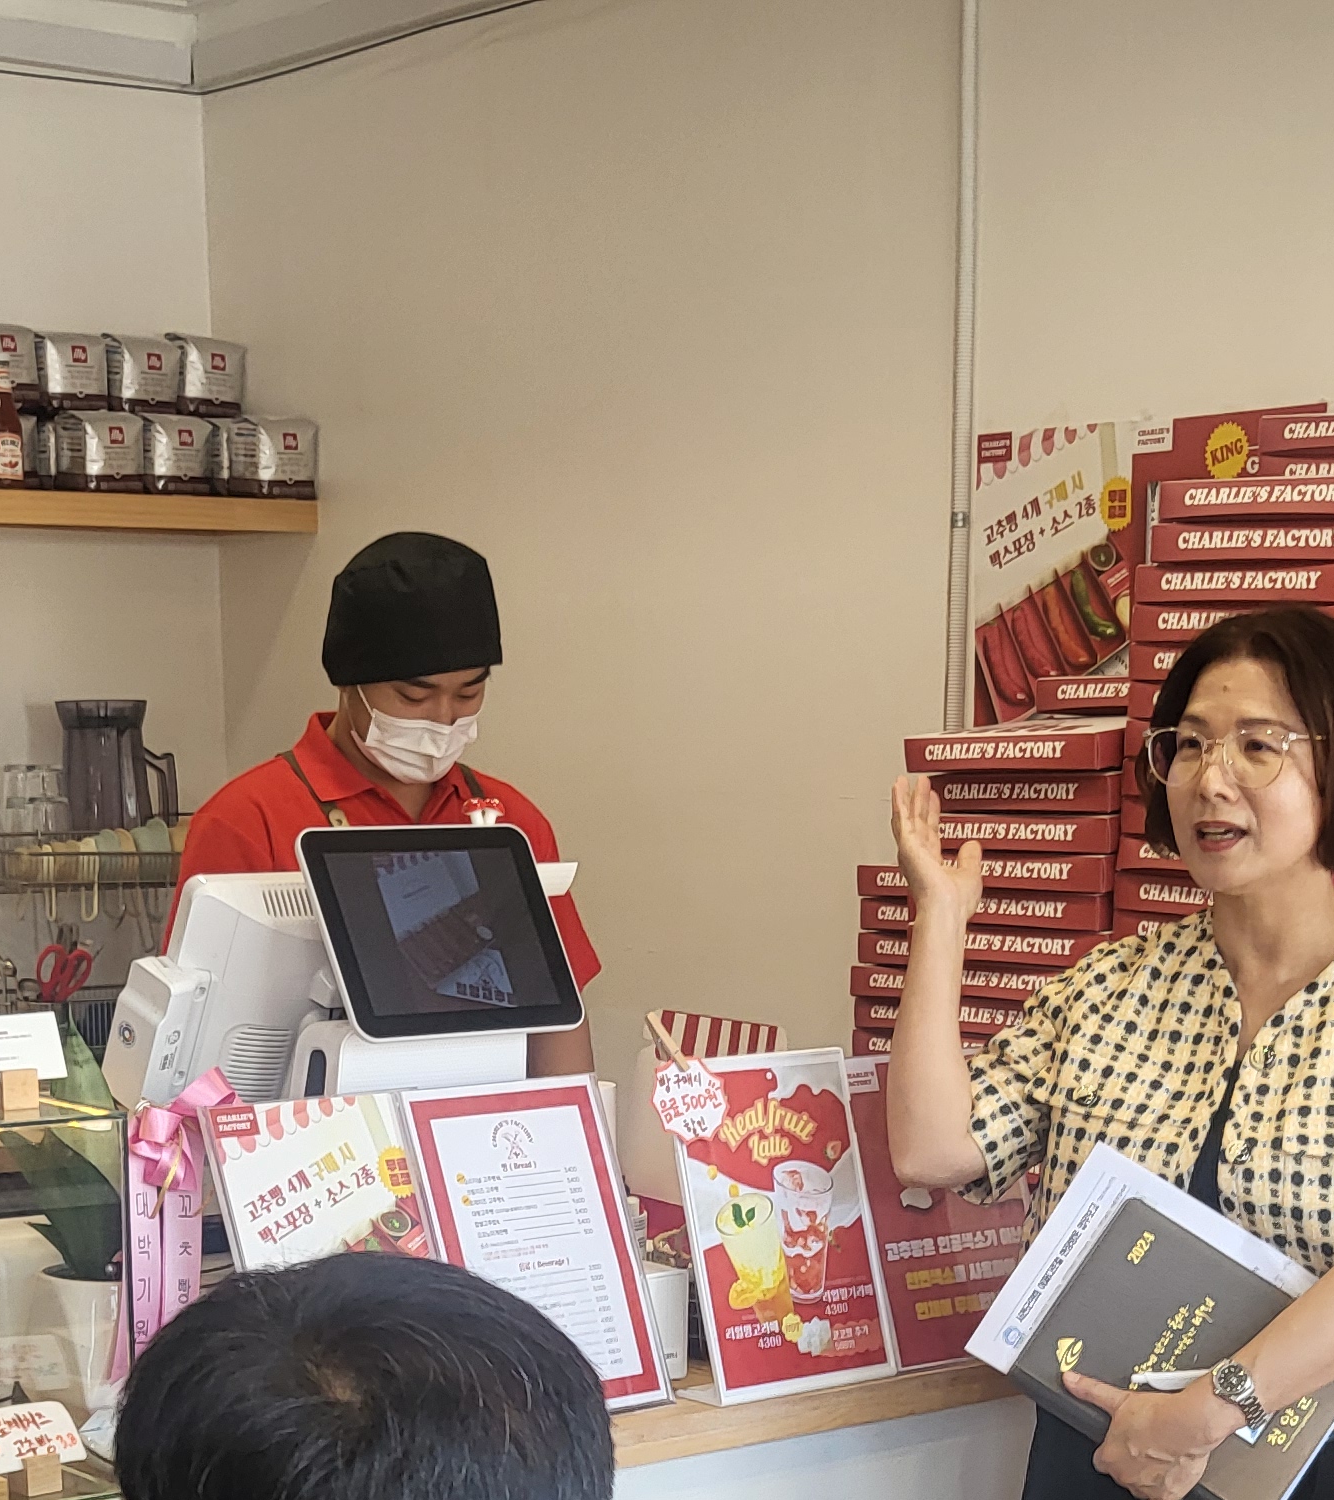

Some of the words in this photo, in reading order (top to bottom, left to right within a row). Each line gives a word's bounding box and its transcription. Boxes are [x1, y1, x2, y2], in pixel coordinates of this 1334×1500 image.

[1209, 438, 1245, 465] KING
[1184, 484, 1271, 506] CHARLIE'S
[983, 511, 1018, 546] 고추빵
[1021, 496, 1041, 521] 4개
[1050, 509, 1075, 537] 소스
[1075, 494, 1096, 520] 2종
[1177, 527, 1264, 550] CHARLIE'S
[1160, 570, 1242, 592] CHARLIE'S
[1242, 569, 1322, 590] FACTORY
[1056, 683, 1130, 700] CHARLIE'S
[925, 744, 995, 760] CHARLIE'S
[996, 741, 1066, 759] FACTORY
[944, 783, 1012, 800] CHARLIE'S
[1012, 783, 1079, 800] FACTORY
[938, 823, 1008, 840] CHARLIE'S
[1008, 824, 1077, 841] FACTORY
[1004, 862, 1072, 880] FACTORY
[997, 900, 1066, 919] FACTORY
[1002, 936, 1074, 955] FACTORY
[658, 1074, 671, 1093] 빵
[660, 1097, 684, 1124] 음료
[683, 1089, 723, 1113] 500원
[721, 1101, 765, 1149] Real
[765, 1100, 816, 1142] fruit
[750, 1134, 790, 1163] Latte
[243, 1184, 287, 1223] 고추빵
[287, 1169, 313, 1195] 4개
[257, 1202, 314, 1245] 박스포장
[326, 1180, 355, 1209] 소스
[351, 1164, 376, 1190] 2종
[1127, 1230, 1156, 1265] 2024
[825, 1302, 849, 1316] 4300
[758, 1335, 782, 1349] 4300
[1266, 1396, 1319, 1446] 청양군
[13, 1434, 56, 1458] 고추빵
